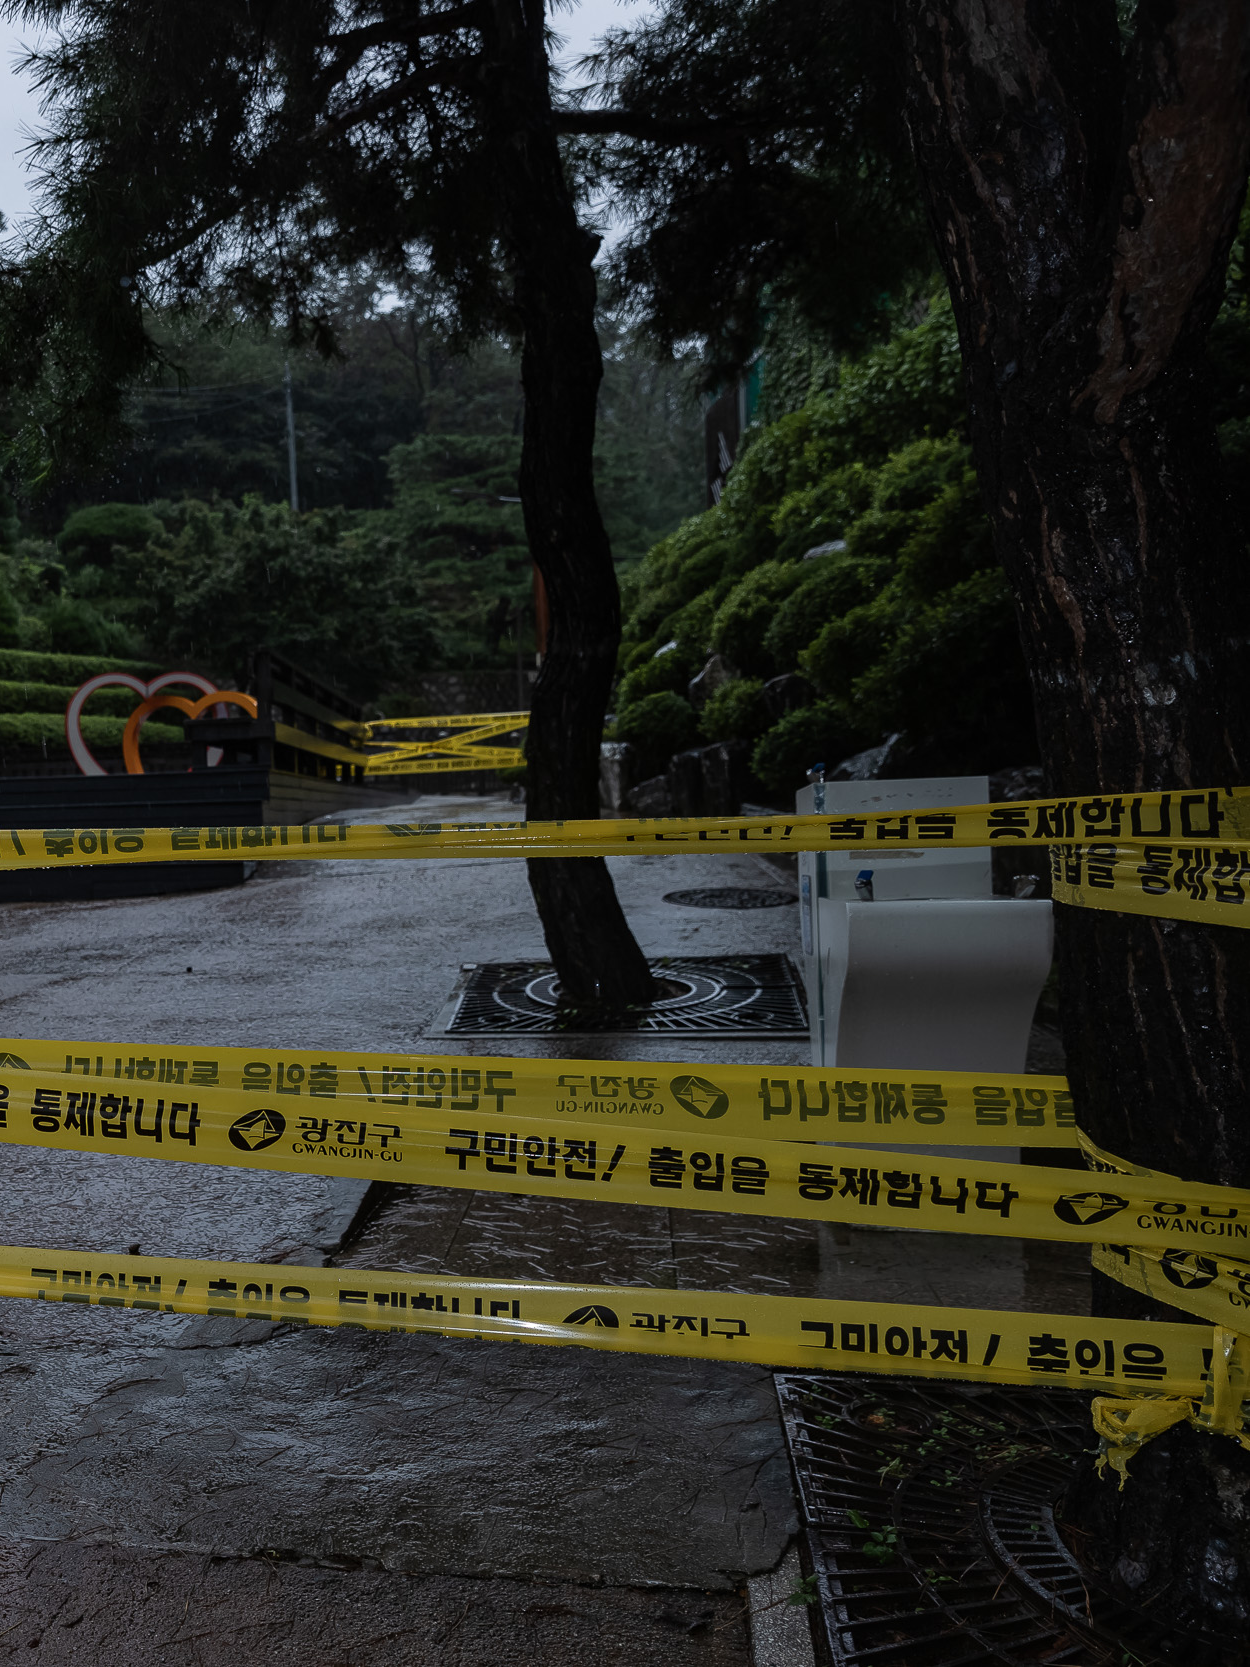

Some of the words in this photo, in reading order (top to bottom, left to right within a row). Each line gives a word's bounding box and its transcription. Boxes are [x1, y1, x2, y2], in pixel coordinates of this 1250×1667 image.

[30, 1087, 202, 1147] 통제합니다
[294, 1115, 404, 1149] 광진구
[291, 1142, 404, 1162] GWANGJIN-GU
[445, 1127, 627, 1183] 구민안전!
[648, 1146, 770, 1196] 출입을
[797, 1161, 1019, 1219] 통제합니다
